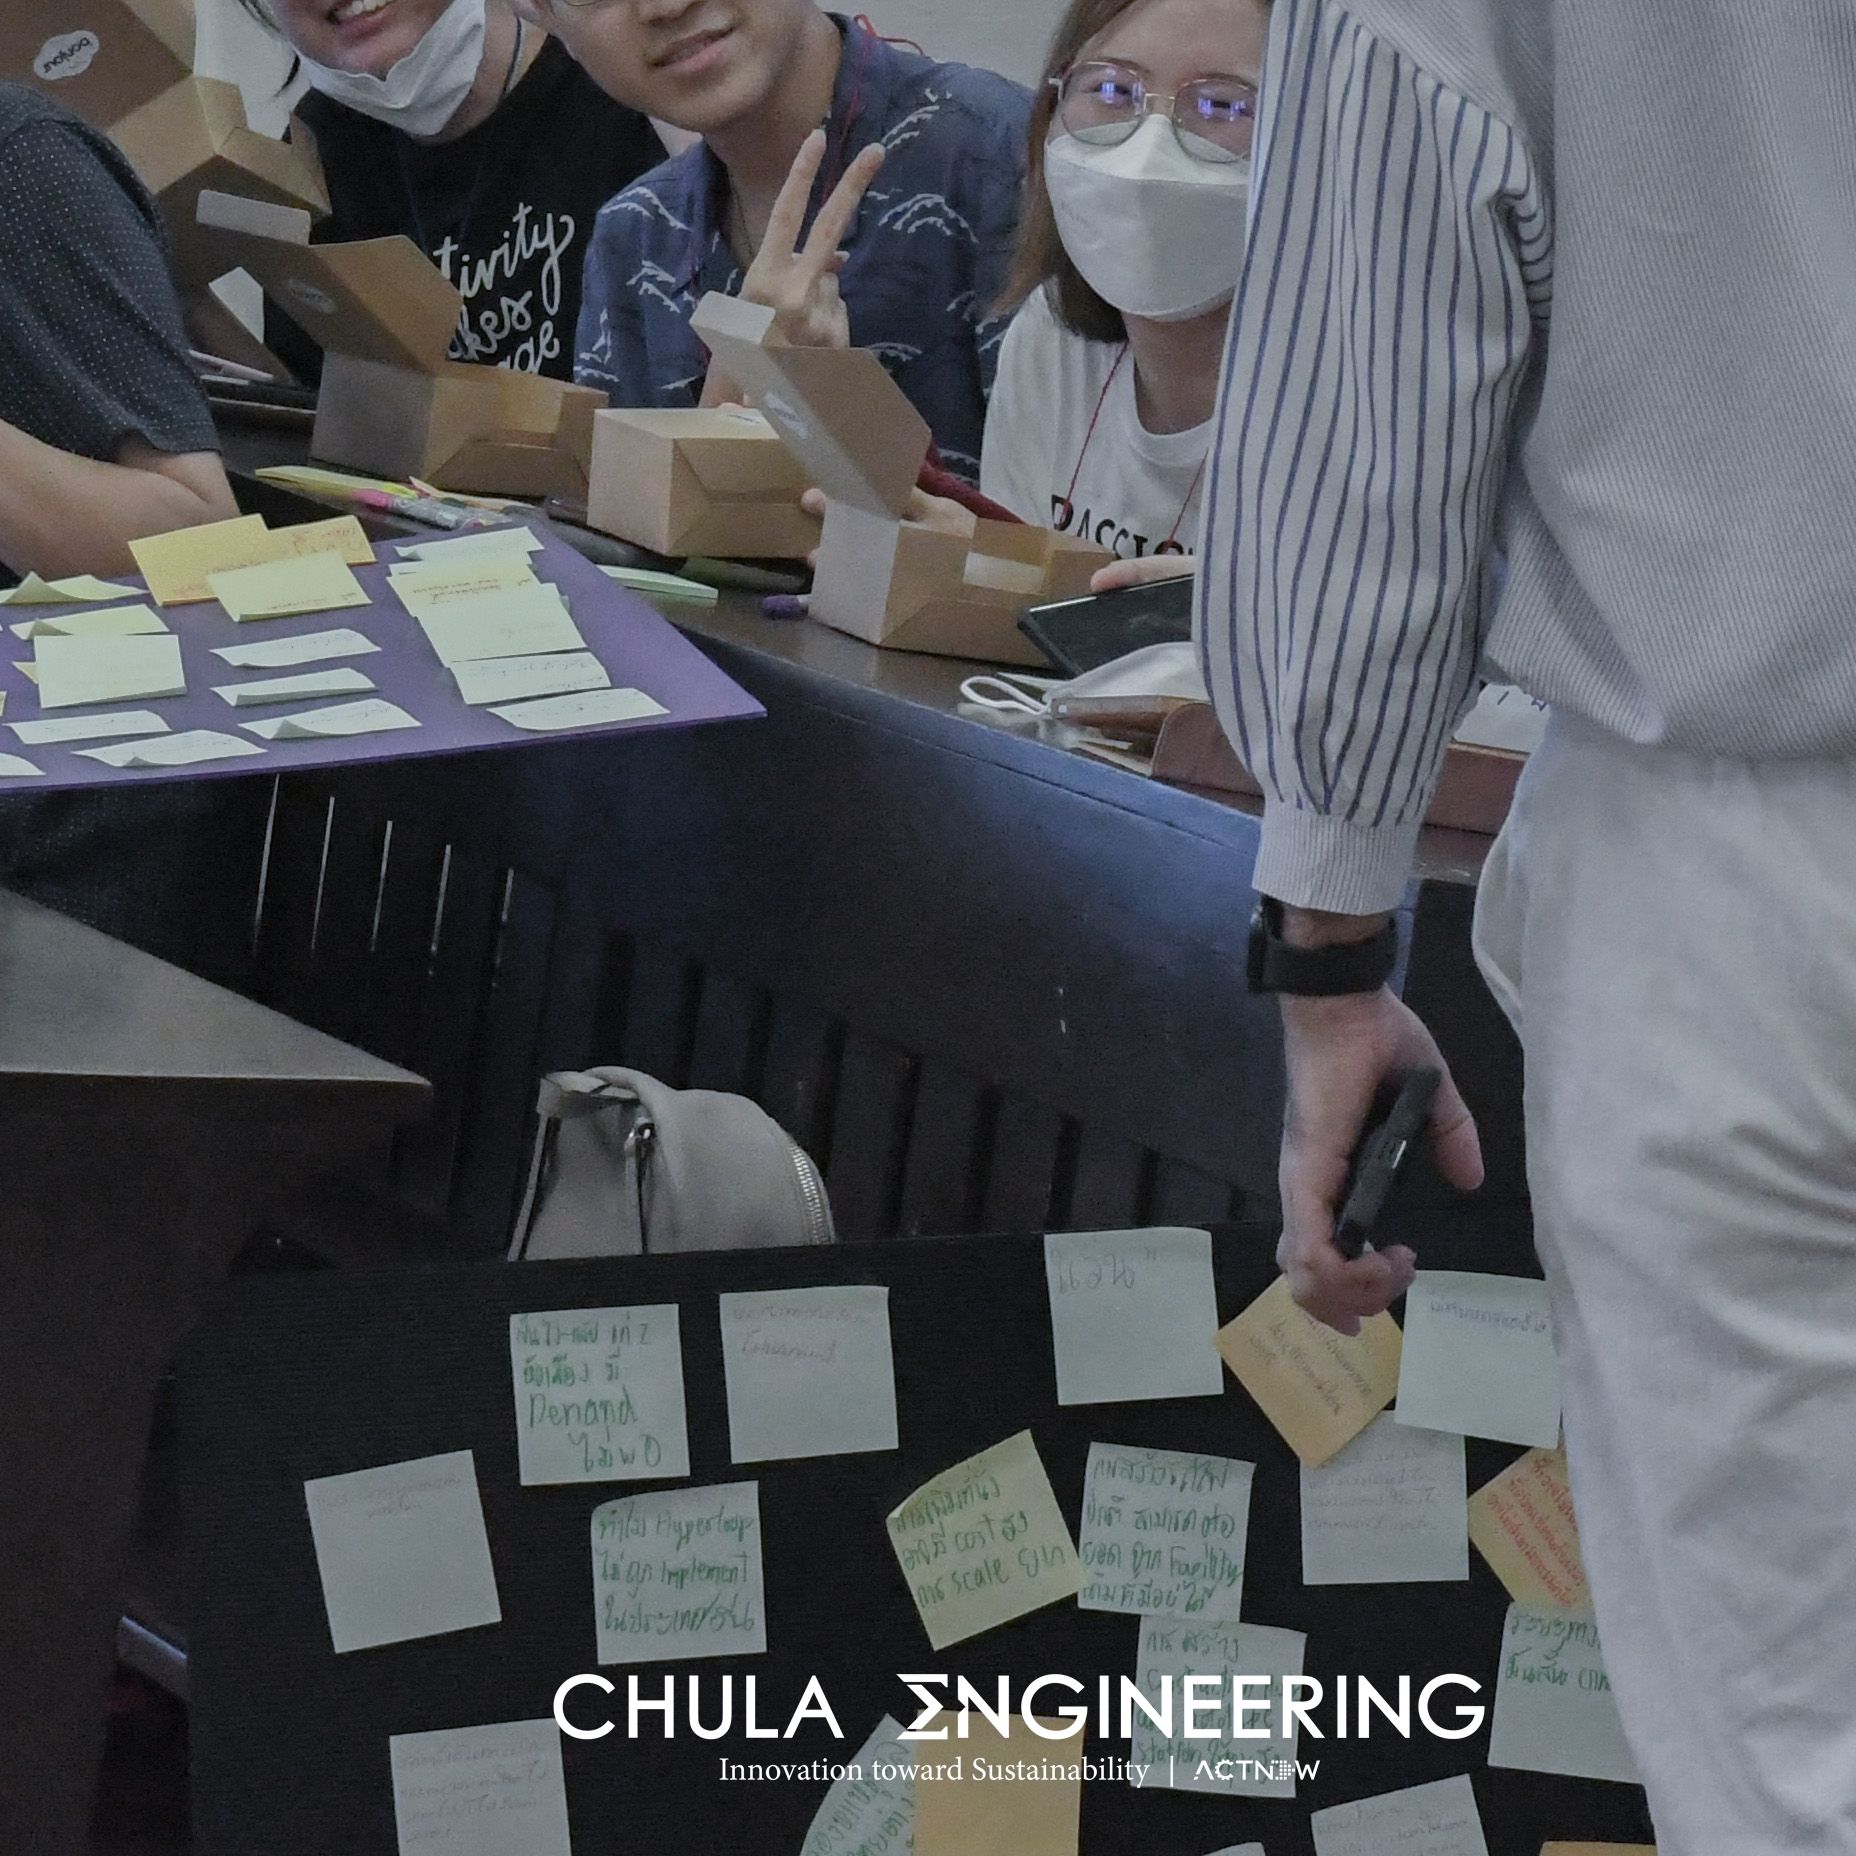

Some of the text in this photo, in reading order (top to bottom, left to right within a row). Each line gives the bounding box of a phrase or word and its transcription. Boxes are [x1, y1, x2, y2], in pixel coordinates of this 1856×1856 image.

[1051, 494, 1194, 559] PASS
[655, 1505, 755, 1552] Hyperloop
[951, 1558, 1010, 1595] scale
